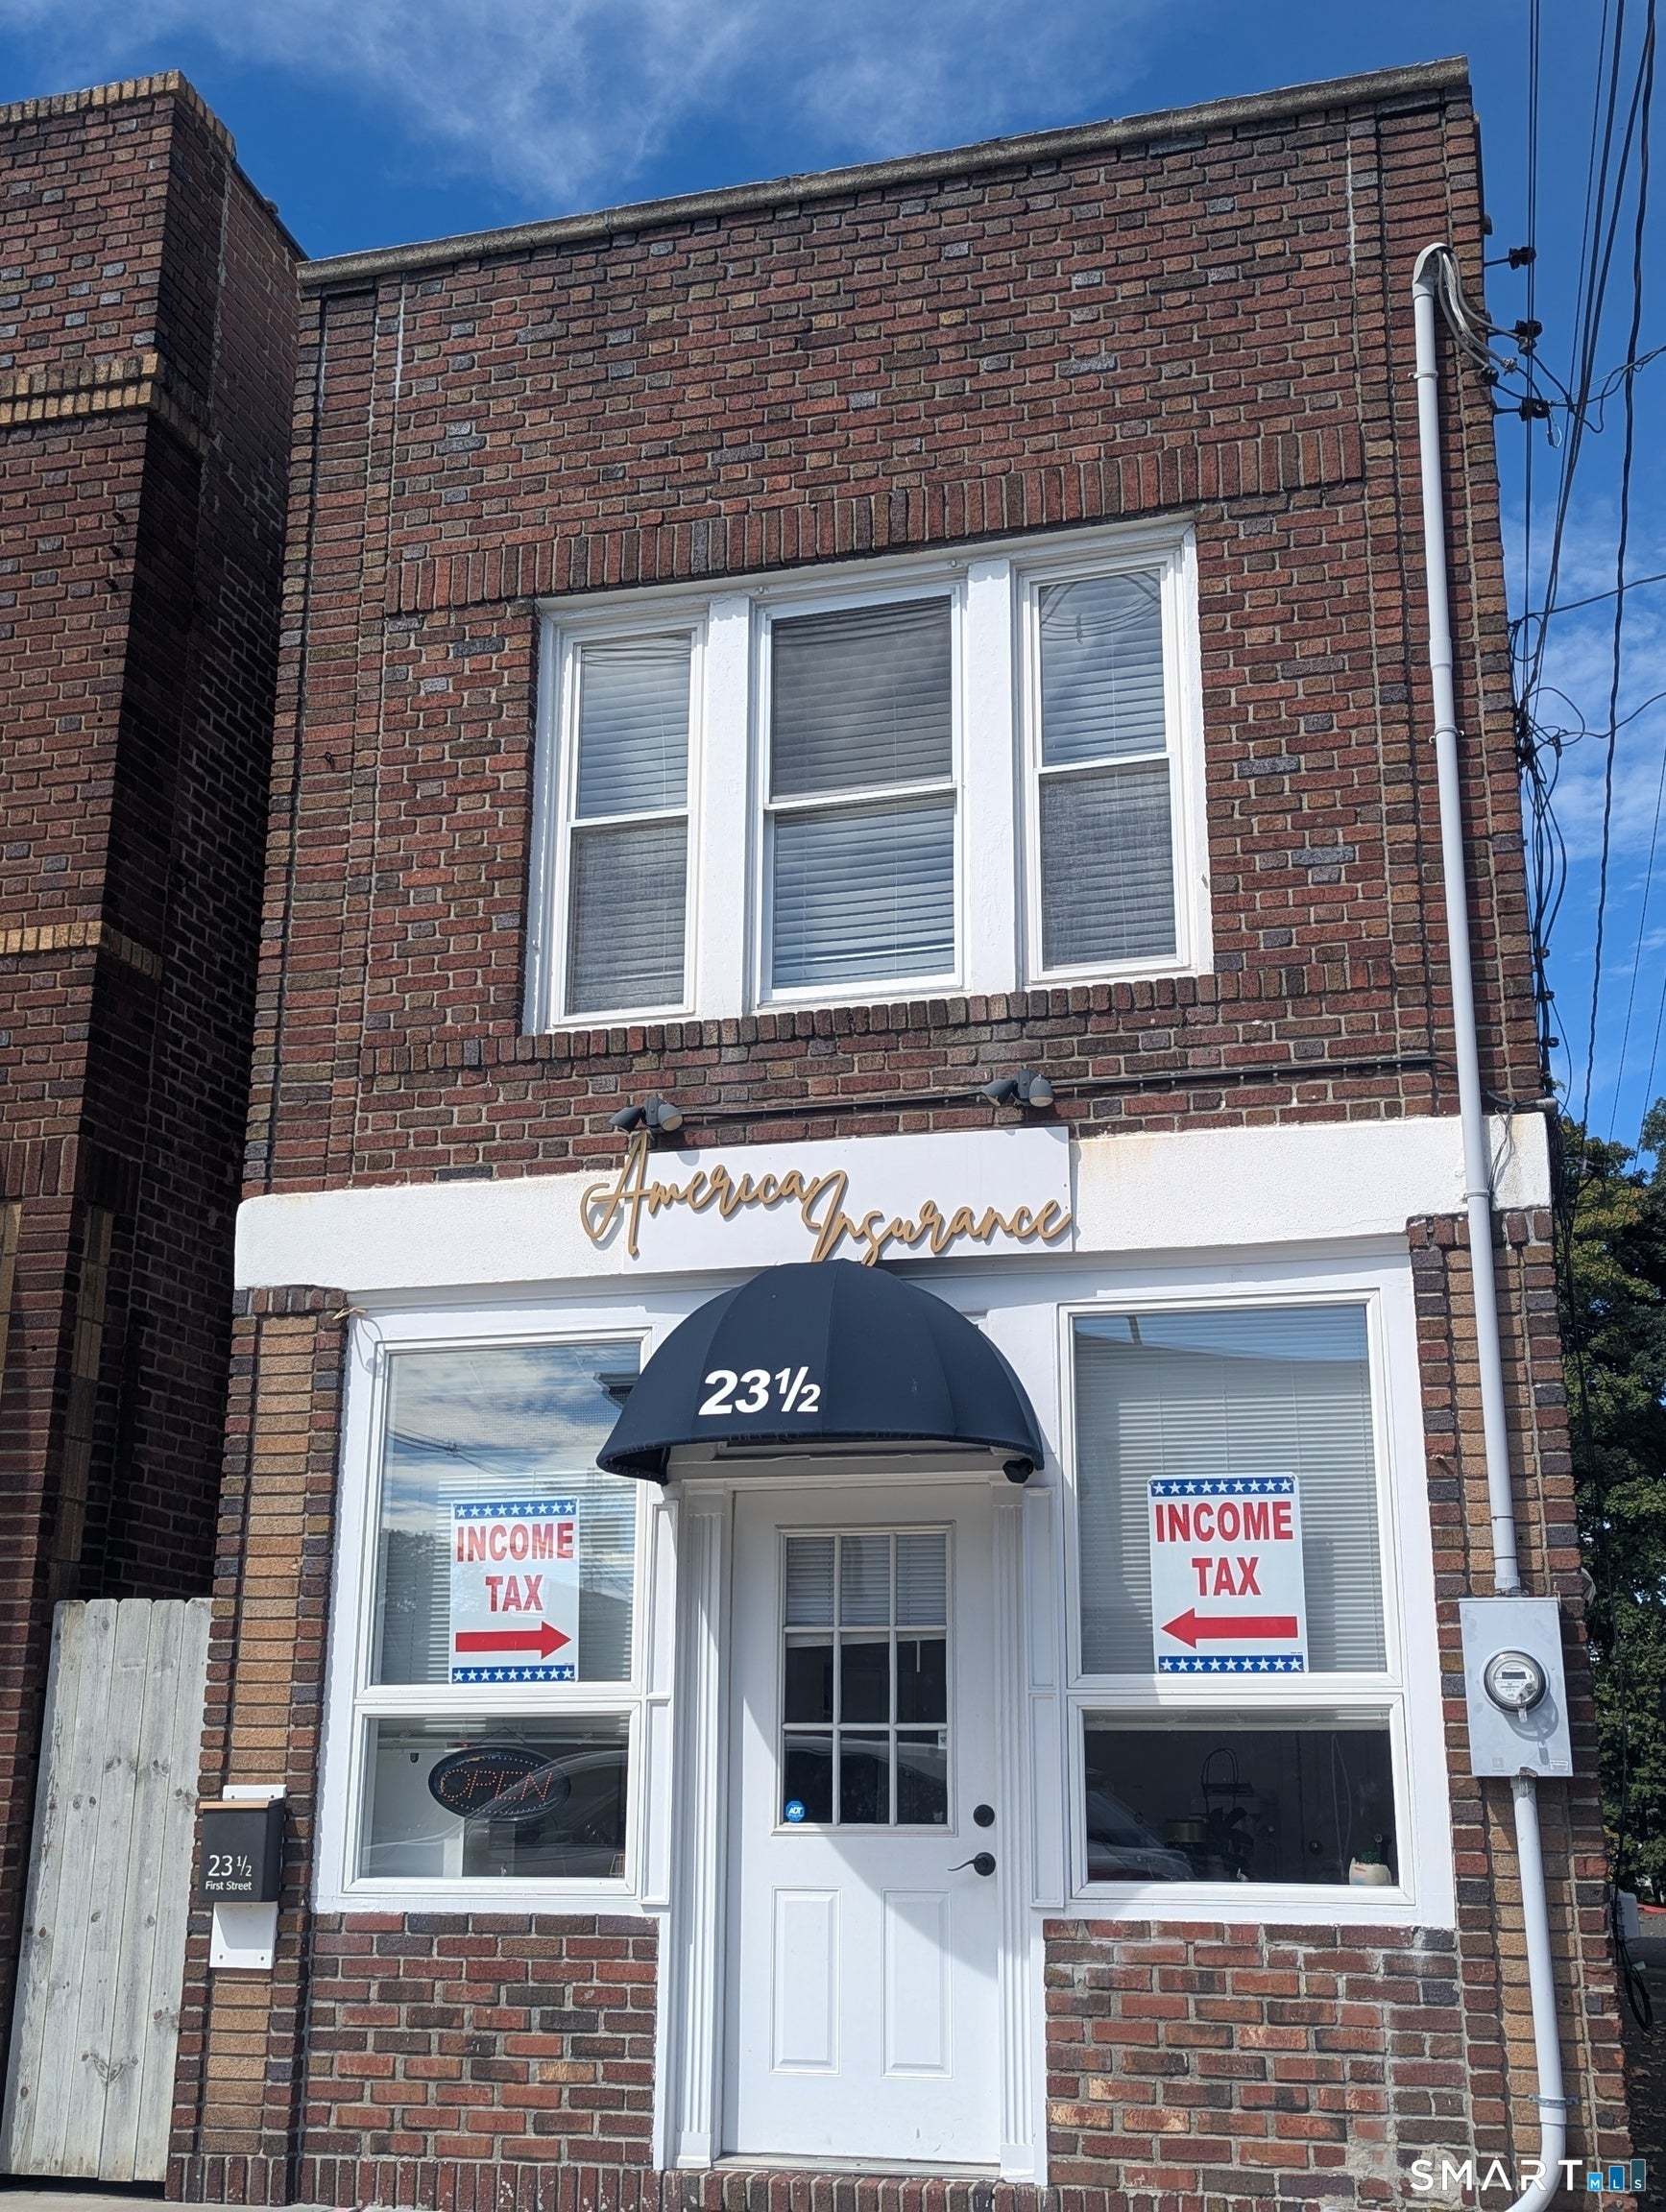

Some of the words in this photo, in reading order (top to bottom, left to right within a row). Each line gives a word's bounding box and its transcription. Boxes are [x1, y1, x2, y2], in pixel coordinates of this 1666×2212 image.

[802, 1169, 1073, 1266] Insurance
[1154, 1501, 1294, 1543] INCOME
[456, 1522, 574, 1563] INCOME
[485, 1574, 543, 1612] TAX
[1192, 1556, 1262, 1597] TAX
[440, 1768, 553, 1801] OPEN
[788, 1806, 803, 1815] ADT
[205, 1880, 224, 1890] First
[226, 1880, 253, 1890] Street
